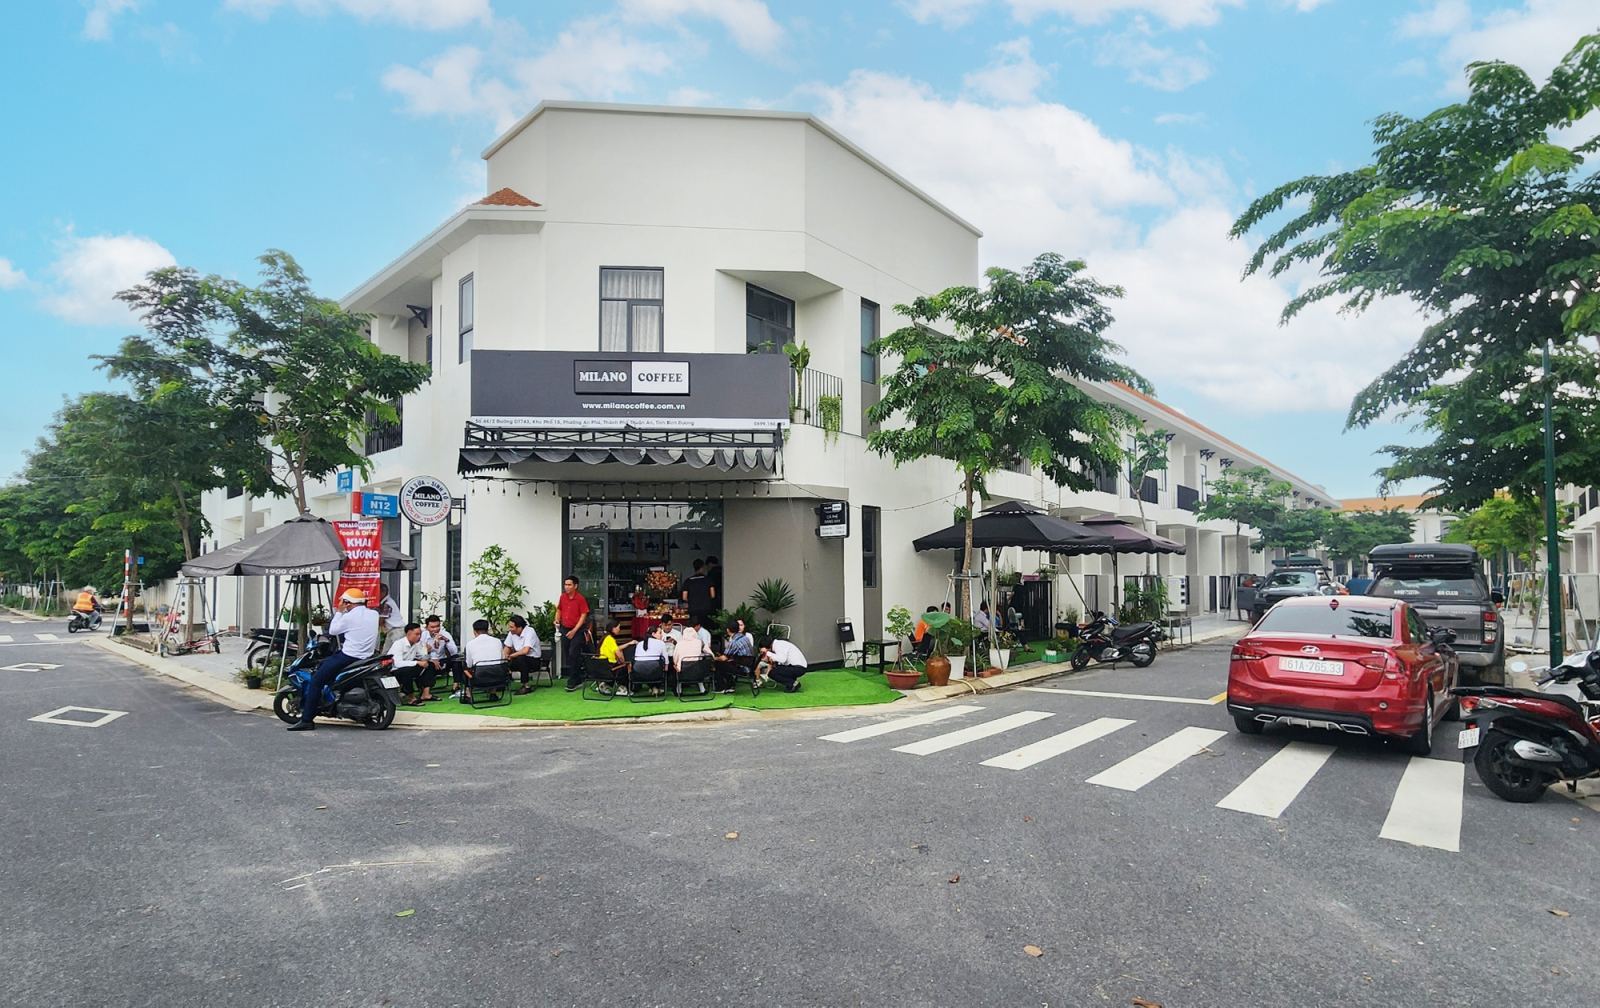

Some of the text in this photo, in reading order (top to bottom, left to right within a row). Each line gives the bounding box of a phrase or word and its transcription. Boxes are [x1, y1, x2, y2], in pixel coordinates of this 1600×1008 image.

[579, 371, 683, 382] MILANO COFFEE
[582, 402, 686, 410] www.milanocoffee.com.vn
[414, 492, 441, 500] MILANO
[370, 501, 391, 510] N12
[346, 538, 372, 547] KHAI
[1287, 659, 1342, 674] 61A-765.33
